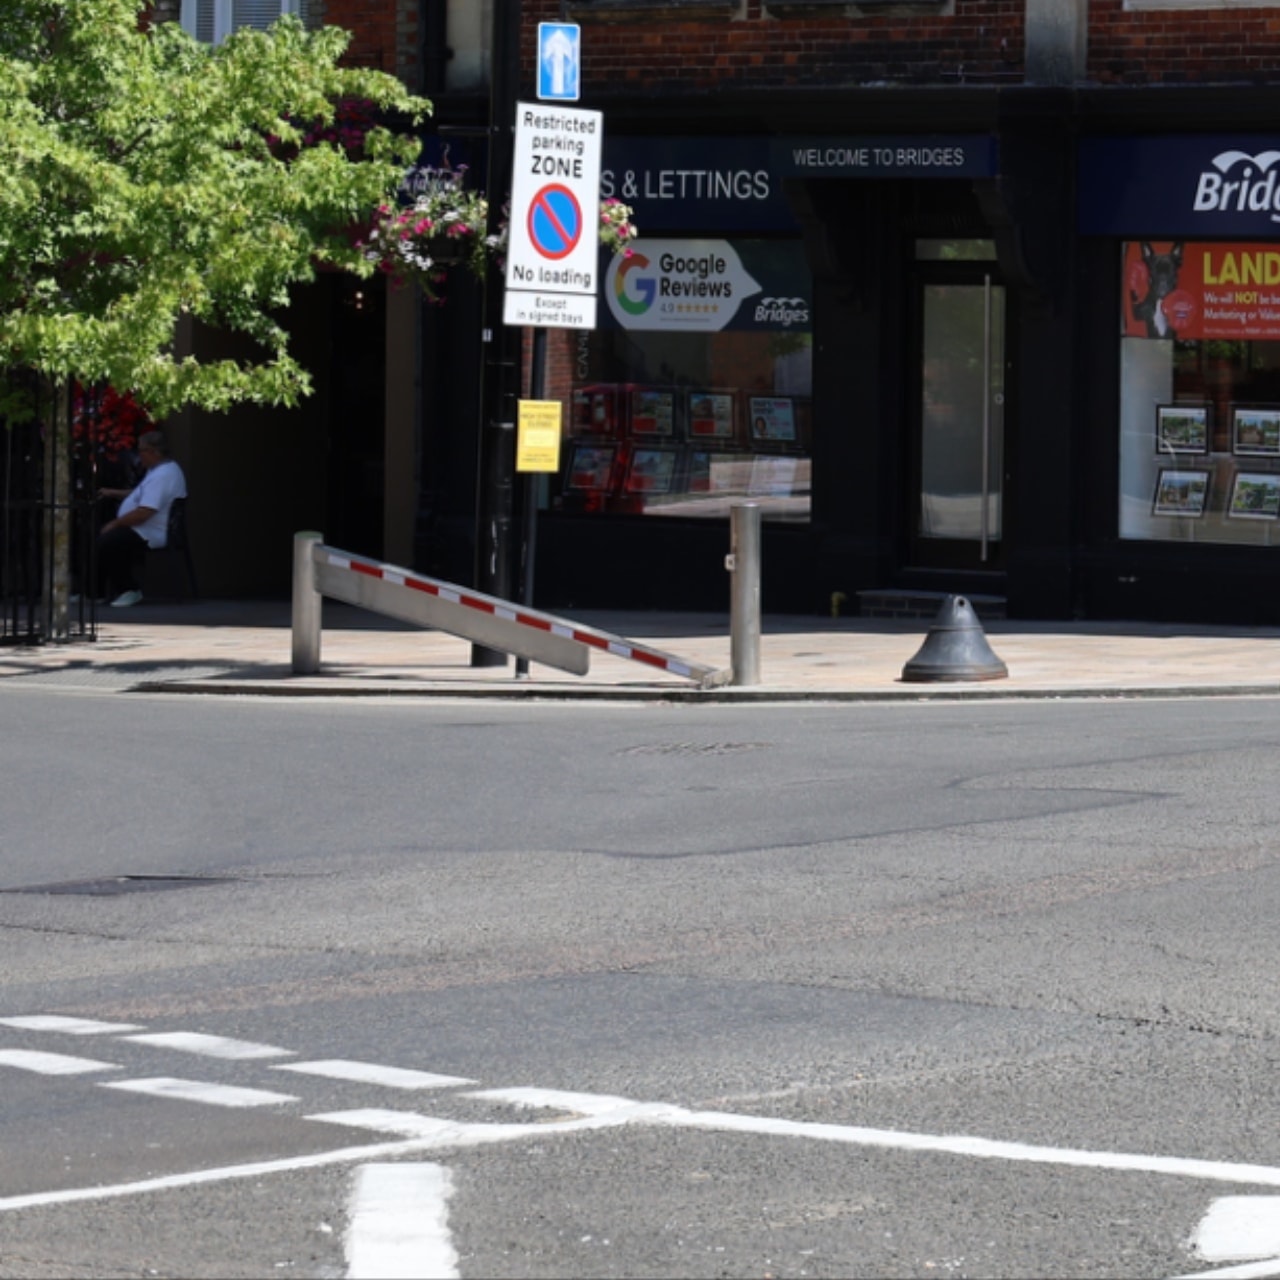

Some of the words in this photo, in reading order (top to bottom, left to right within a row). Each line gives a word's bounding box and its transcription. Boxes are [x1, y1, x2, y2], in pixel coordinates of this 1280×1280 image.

[523, 111, 596, 134] Restricted
[531, 136, 584, 156] parking
[531, 155, 583, 179] ZONE
[793, 149, 869, 166] WELCOME
[873, 149, 894, 166] TO
[896, 149, 965, 167] BRIDGES
[621, 171, 638, 198] &
[645, 170, 769, 199] LETTINGS
[659, 253, 726, 279] Google
[513, 265, 534, 281] No
[539, 267, 591, 289] loading
[659, 277, 732, 298] Reviews
[535, 297, 567, 310] Except
[1203, 291, 1217, 304] We
[1234, 291, 1259, 305] NOT
[1259, 292, 1268, 304] be
[529, 310, 559, 323] signed
[561, 311, 583, 325] bays
[754, 303, 810, 325] Bridges
[1203, 308, 1247, 325] Marketing
[1247, 312, 1257, 321] or
